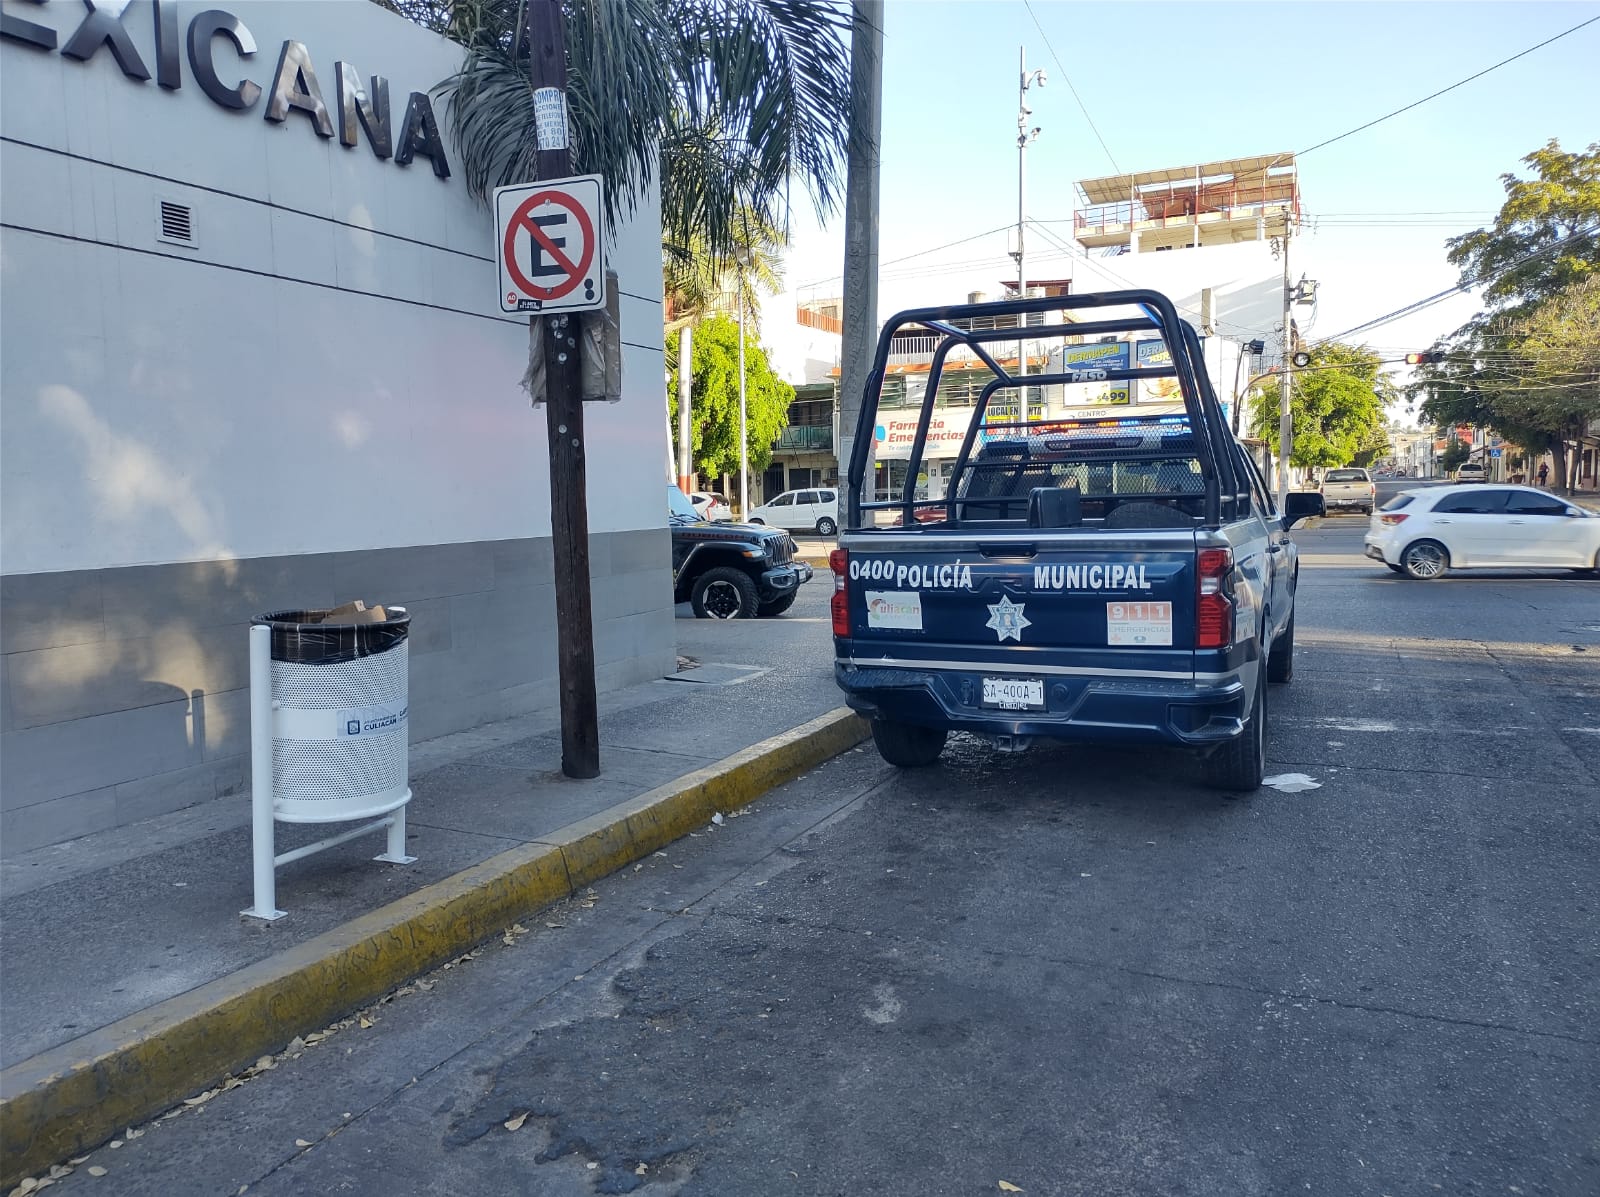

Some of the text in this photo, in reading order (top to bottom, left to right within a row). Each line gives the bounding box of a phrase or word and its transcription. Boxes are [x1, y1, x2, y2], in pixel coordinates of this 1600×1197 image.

[987, 406, 1008, 416] LOCAL
[889, 419, 945, 431] Farmcia
[888, 430, 965, 443] Emeencias
[850, 559, 1151, 590] 0400 POLICÍA MUNICIPAL
